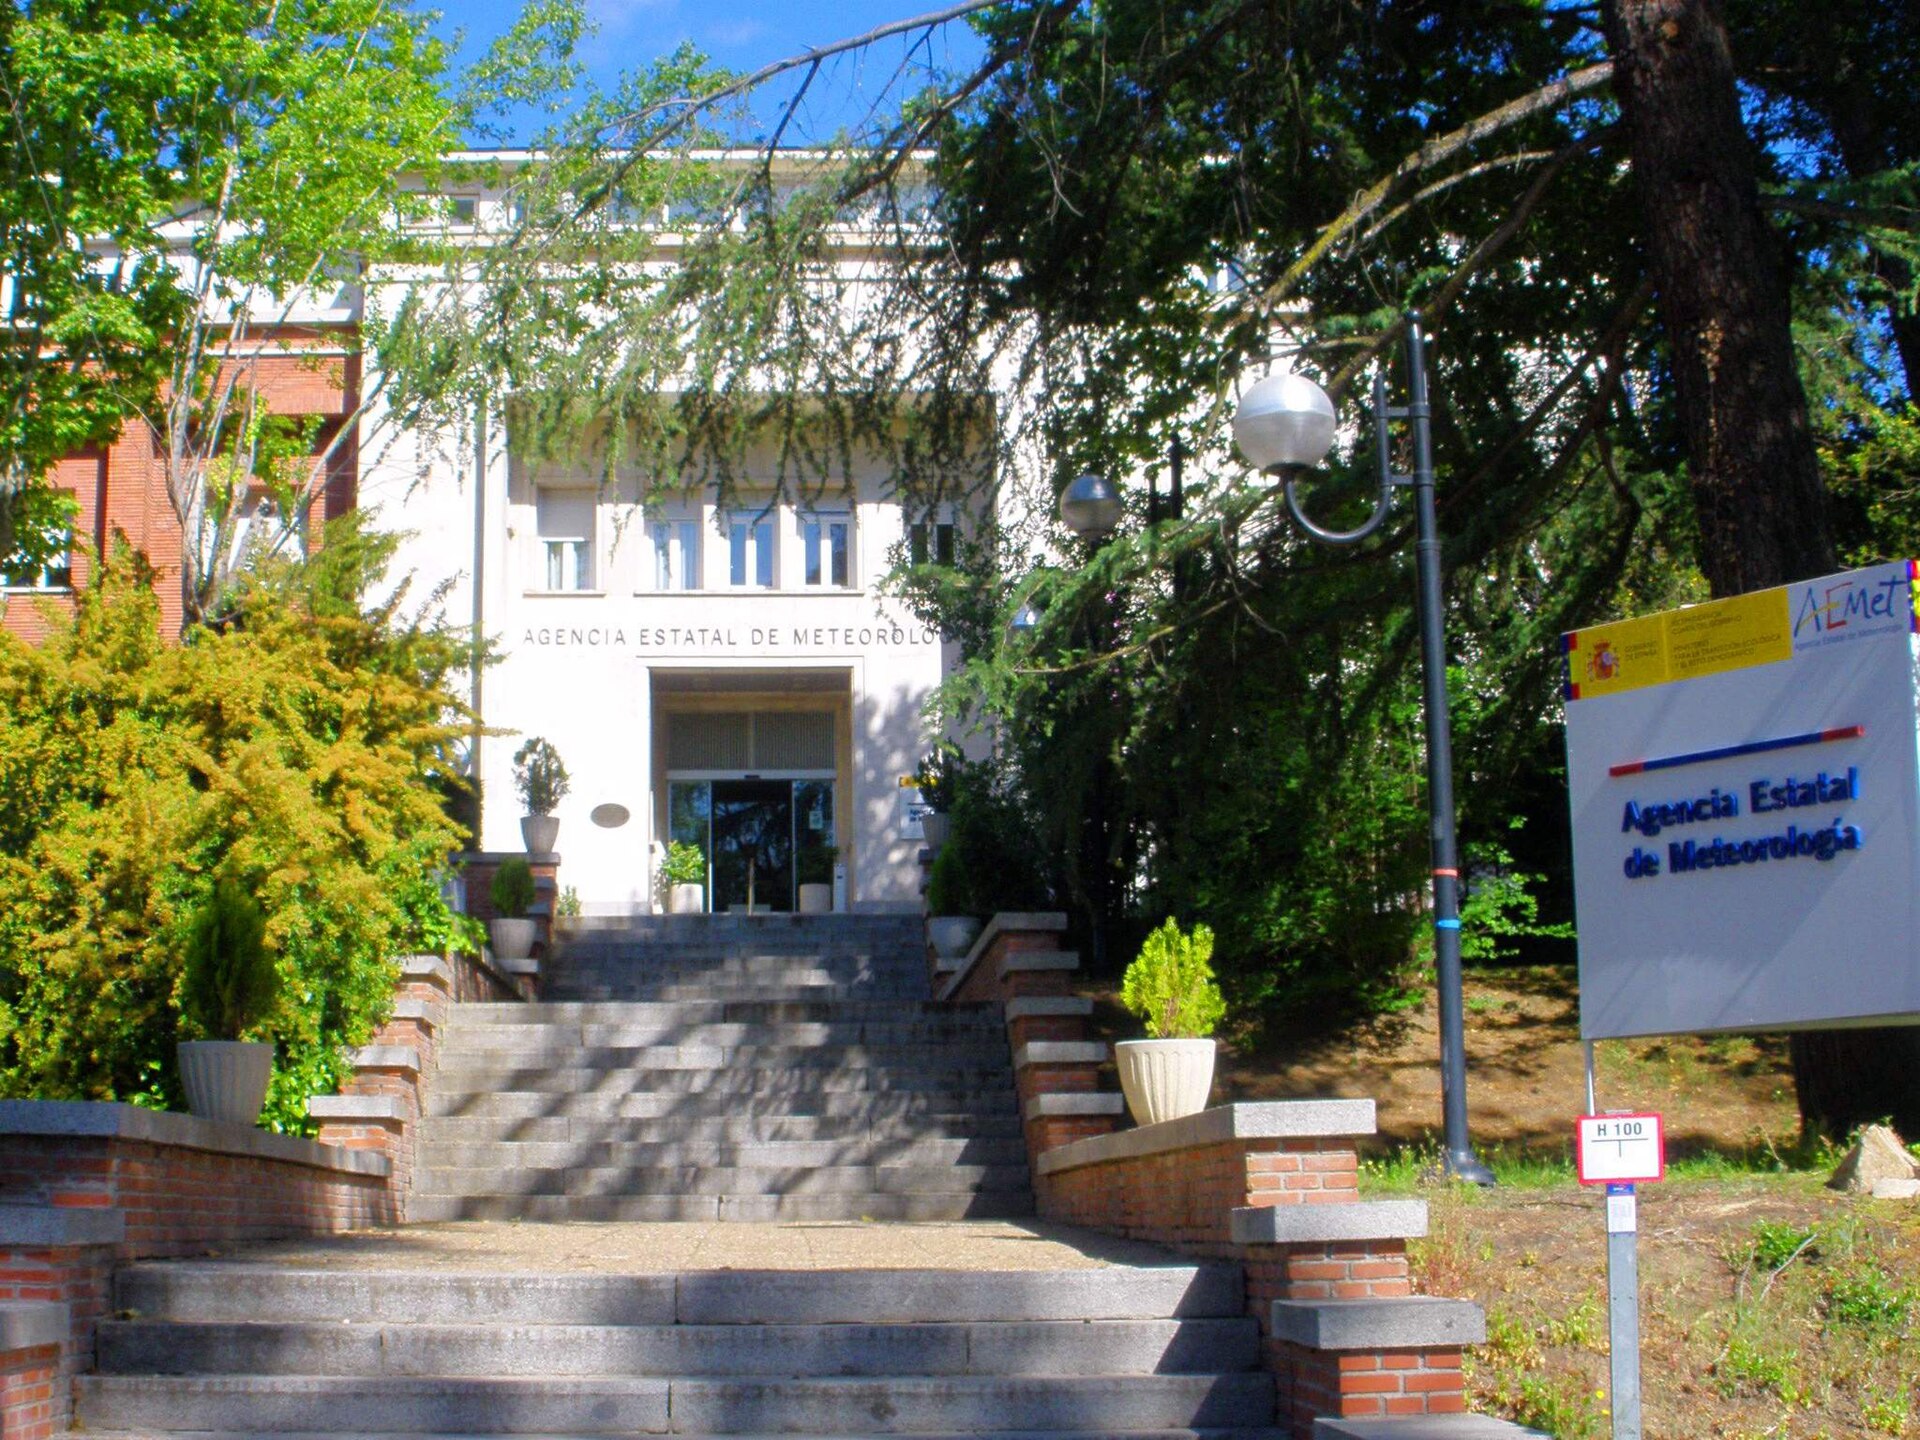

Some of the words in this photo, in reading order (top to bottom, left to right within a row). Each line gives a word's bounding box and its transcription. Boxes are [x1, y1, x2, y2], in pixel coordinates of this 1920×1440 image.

[523, 628, 627, 645] AGENCIA
[640, 628, 737, 645] ESTATAL
[752, 628, 779, 645] DE
[1621, 788, 1739, 837] Agencia
[1750, 766, 1860, 813] Estatal
[1624, 848, 1660, 879] de
[1668, 817, 1862, 875] Meteorología
[1597, 1123, 1607, 1136] H
[1614, 1122, 1642, 1136] 100
